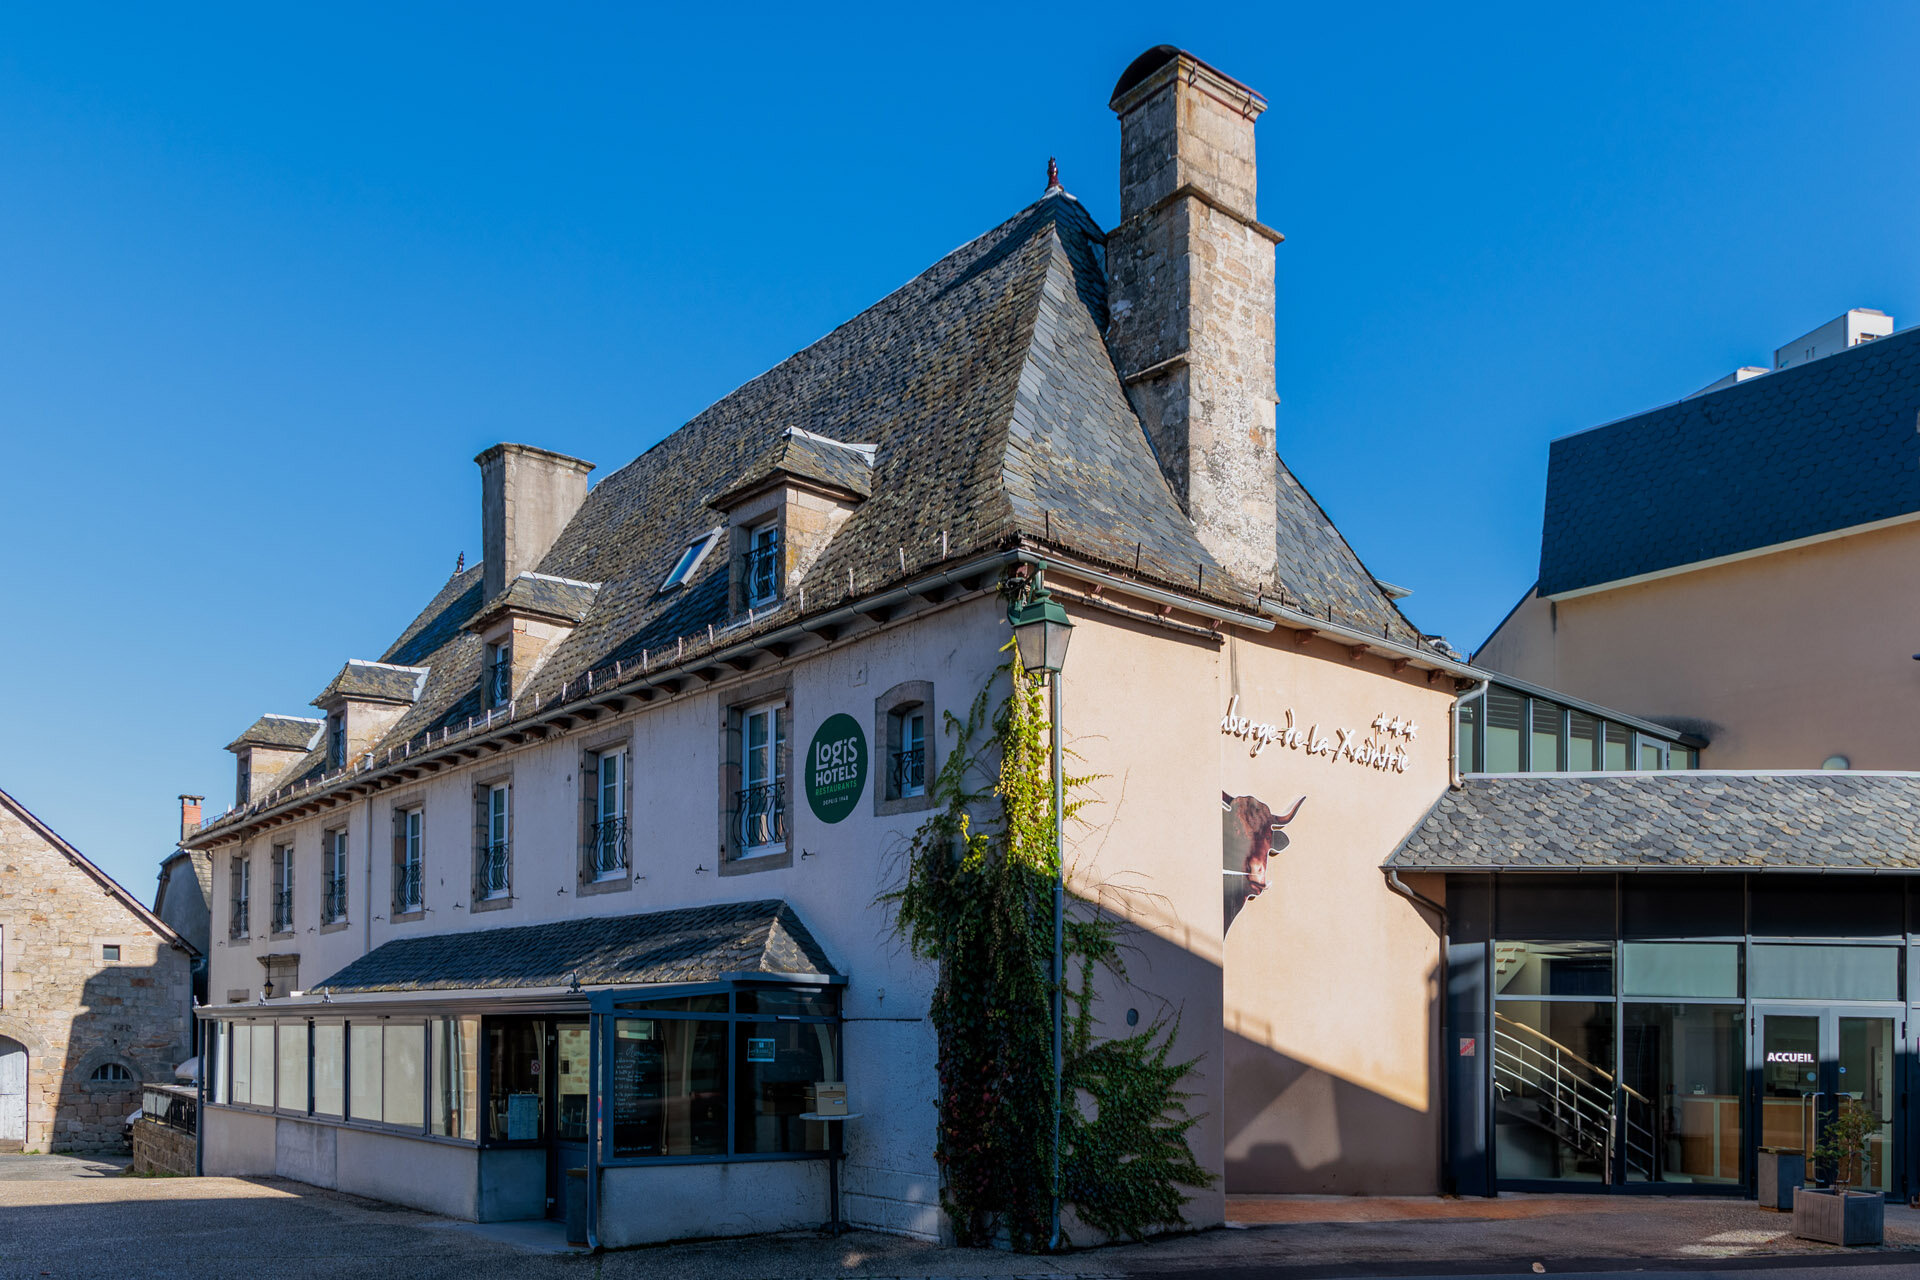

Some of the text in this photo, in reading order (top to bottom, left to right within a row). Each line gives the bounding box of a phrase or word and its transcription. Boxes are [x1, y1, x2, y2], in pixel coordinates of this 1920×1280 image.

[1221, 694, 1282, 758] berge
[1284, 708, 1304, 750] de
[1307, 723, 1330, 755] la
[815, 763, 858, 787] HOTELS
[815, 779, 858, 796] RESTAURANTS
[1767, 1052, 1814, 1063] ACCUEIL
